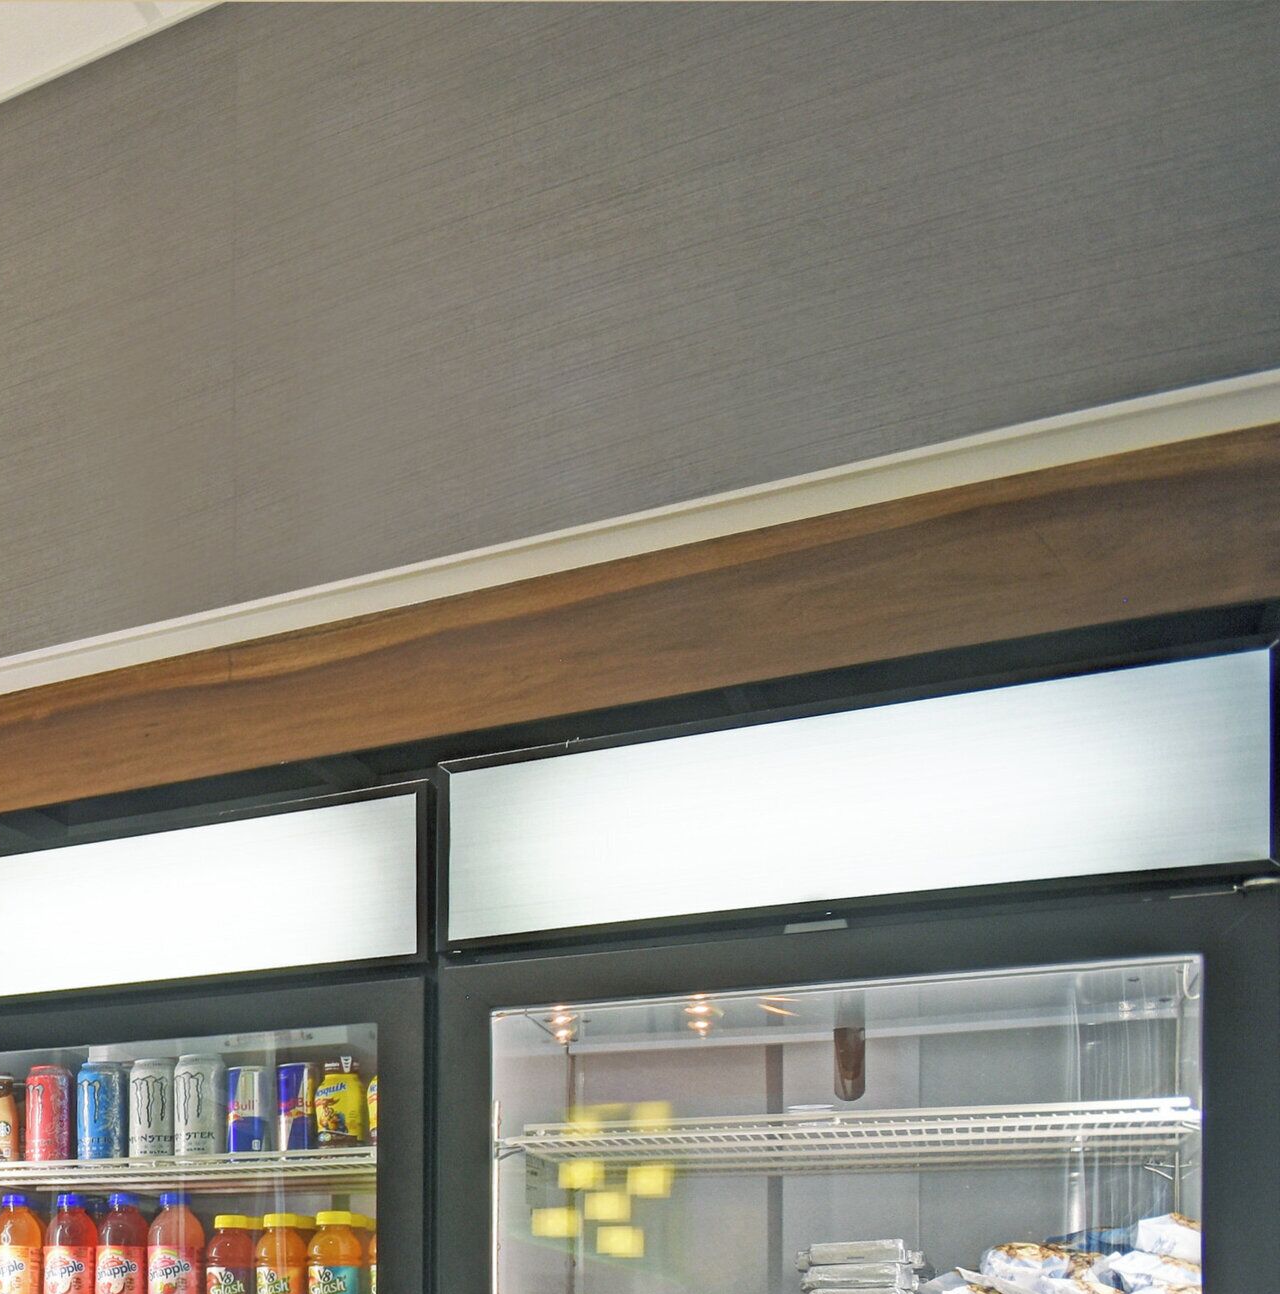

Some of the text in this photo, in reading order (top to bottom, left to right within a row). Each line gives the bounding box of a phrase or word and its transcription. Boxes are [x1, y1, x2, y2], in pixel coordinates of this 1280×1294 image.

[219, 1269, 234, 1285] V8
[263, 1268, 277, 1284] V8
[319, 1268, 333, 1285] V8
